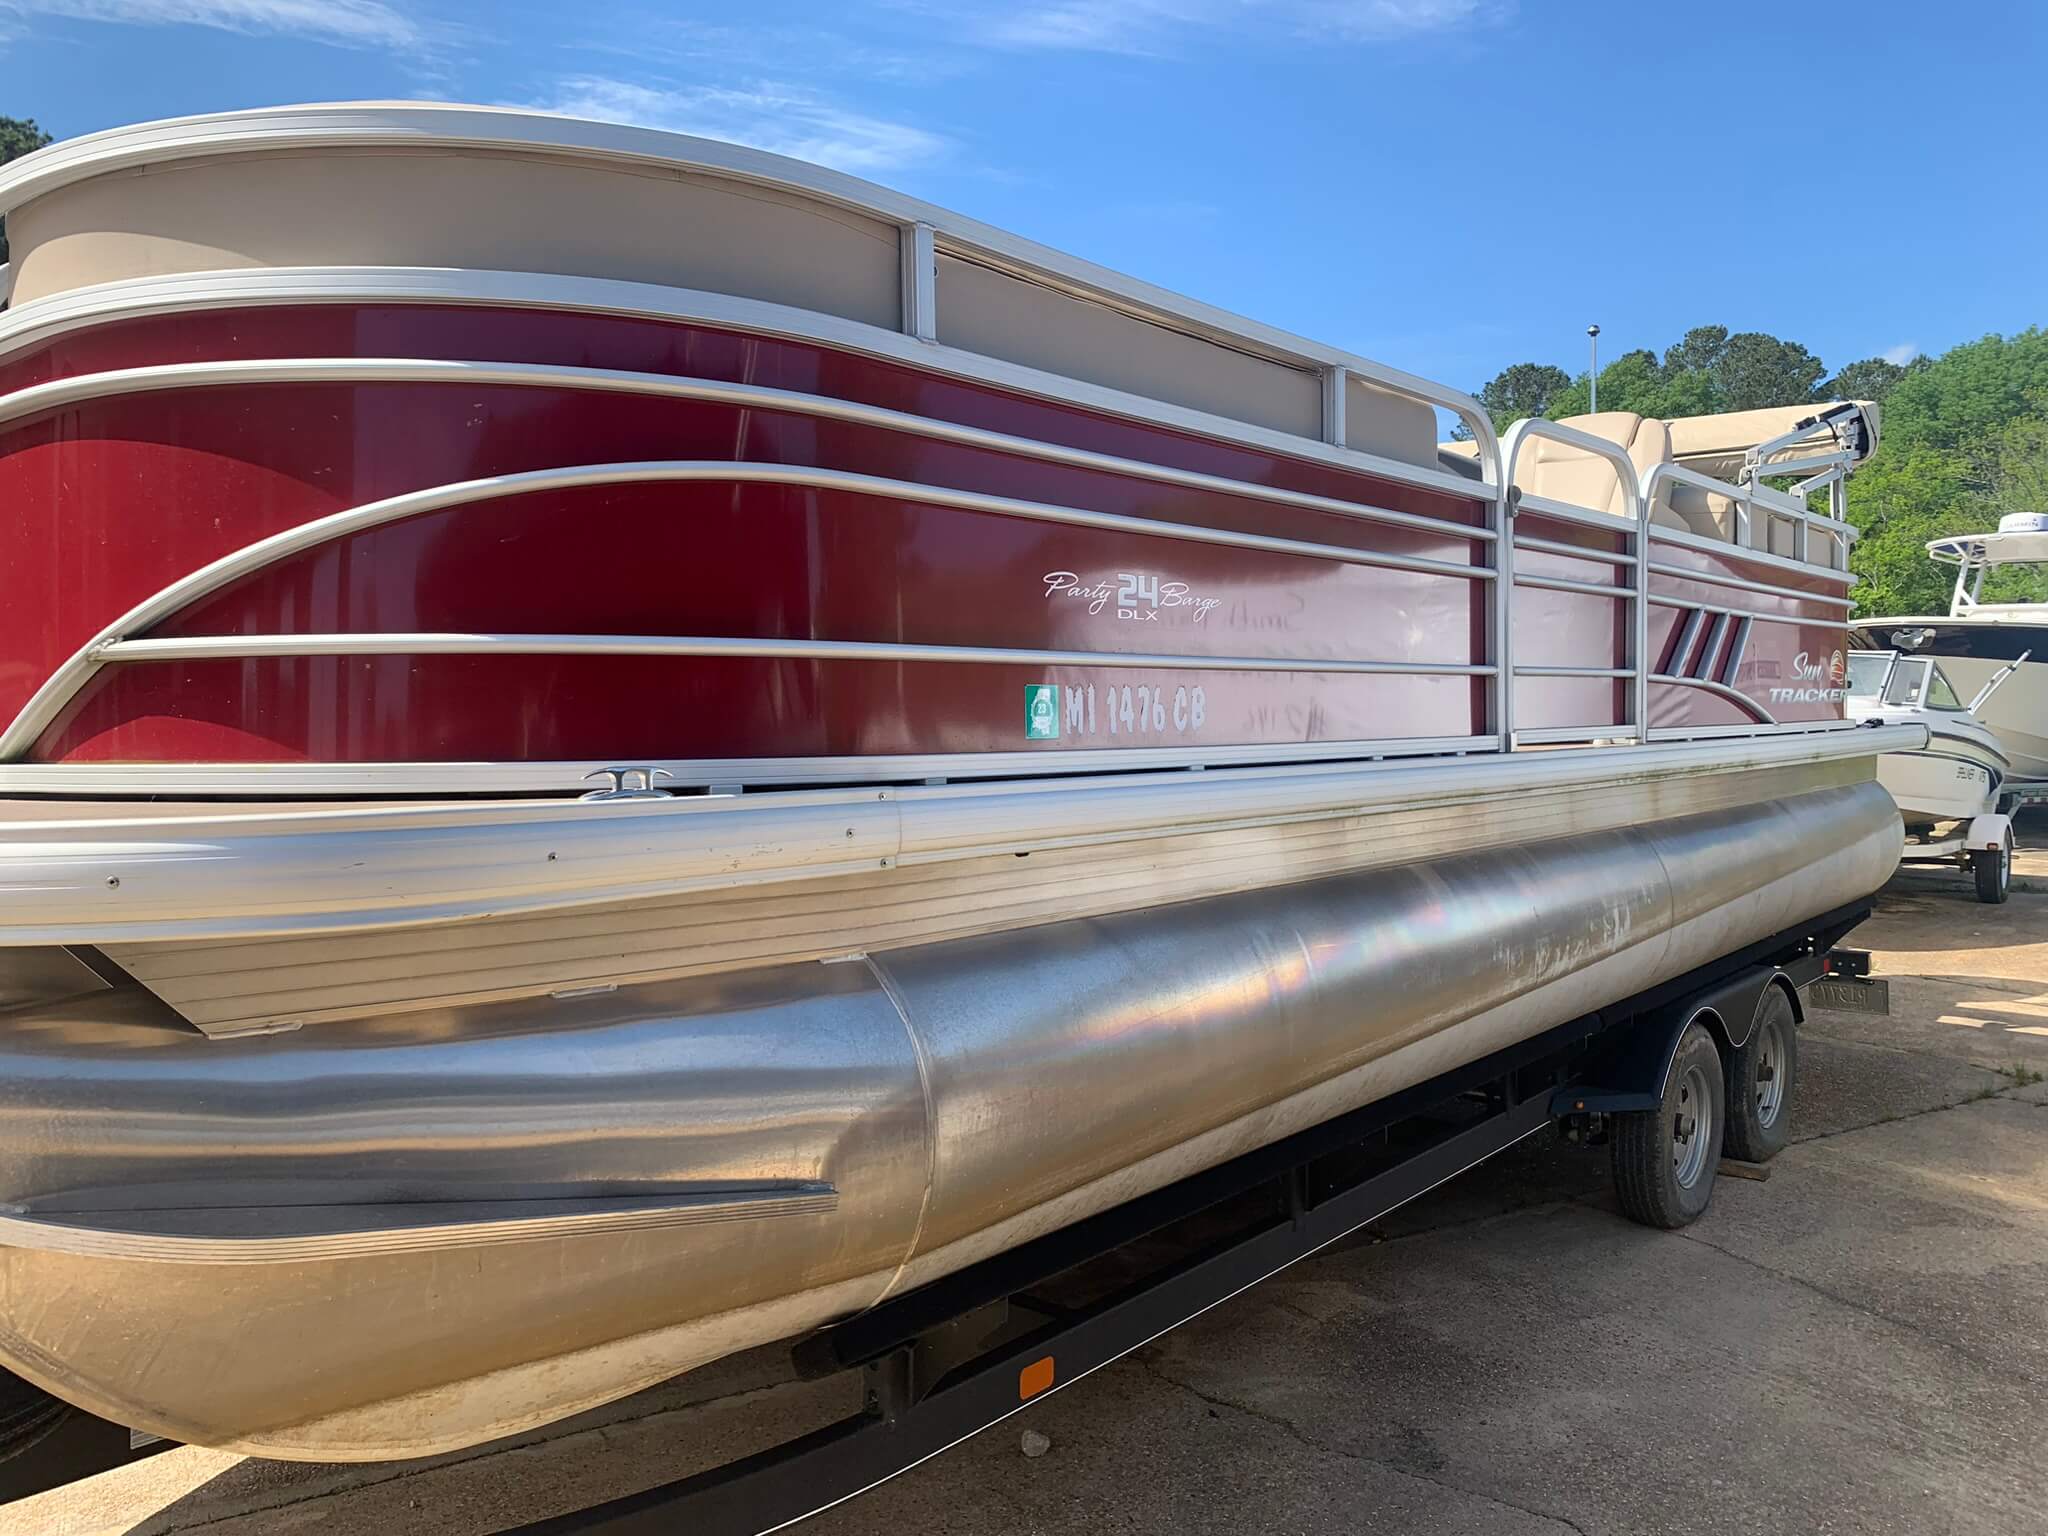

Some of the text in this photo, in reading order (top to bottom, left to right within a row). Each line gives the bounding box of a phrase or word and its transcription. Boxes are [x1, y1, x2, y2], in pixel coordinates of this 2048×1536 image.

[1043, 571, 1117, 615] Party
[1117, 573, 1159, 608] 24
[1159, 582, 1223, 622] Barge
[1117, 609, 1159, 621] DLX
[1791, 652, 1824, 680] Sun
[1037, 703, 1047, 714] 23
[1107, 684, 1167, 735] 1476
[1173, 685, 1206, 732] CB
